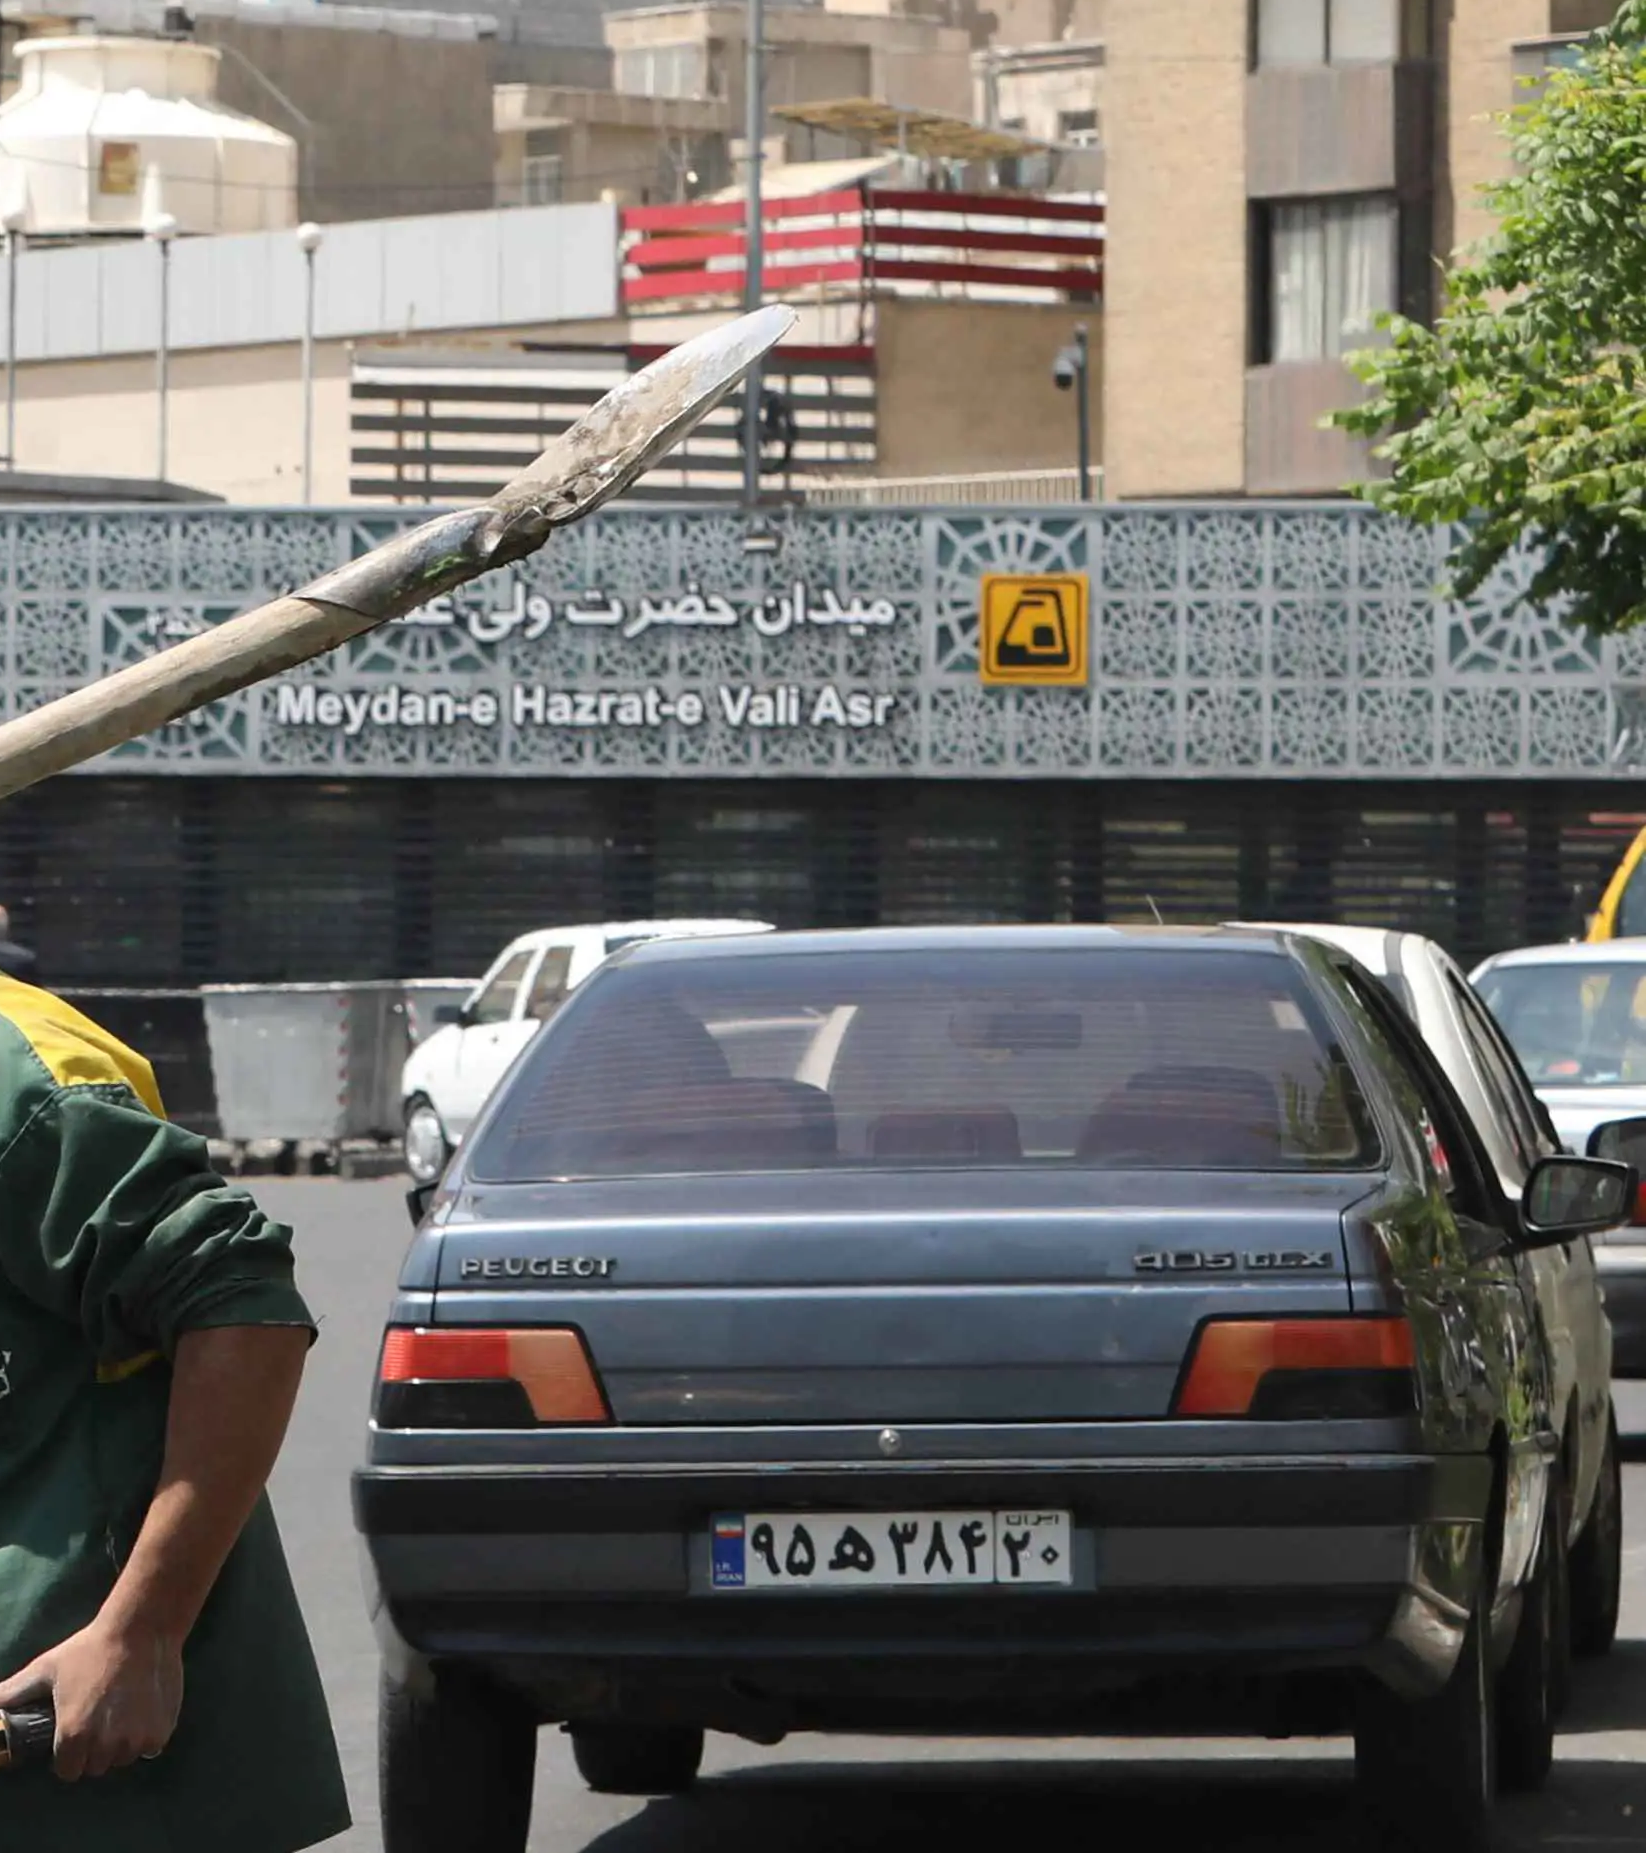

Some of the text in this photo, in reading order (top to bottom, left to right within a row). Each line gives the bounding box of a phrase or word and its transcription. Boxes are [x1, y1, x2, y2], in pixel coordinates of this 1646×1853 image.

[467, 581, 555, 643] ولی
[563, 583, 740, 638] حضرت
[752, 582, 897, 637] میدان
[276, 682, 896, 736] Meydan-e Hazrat-e Vali Asr
[460, 1256, 618, 1279] PEUGEOT
[1133, 1250, 1238, 1273] 405
[1002, 1530, 1061, 1578] ۲۰
